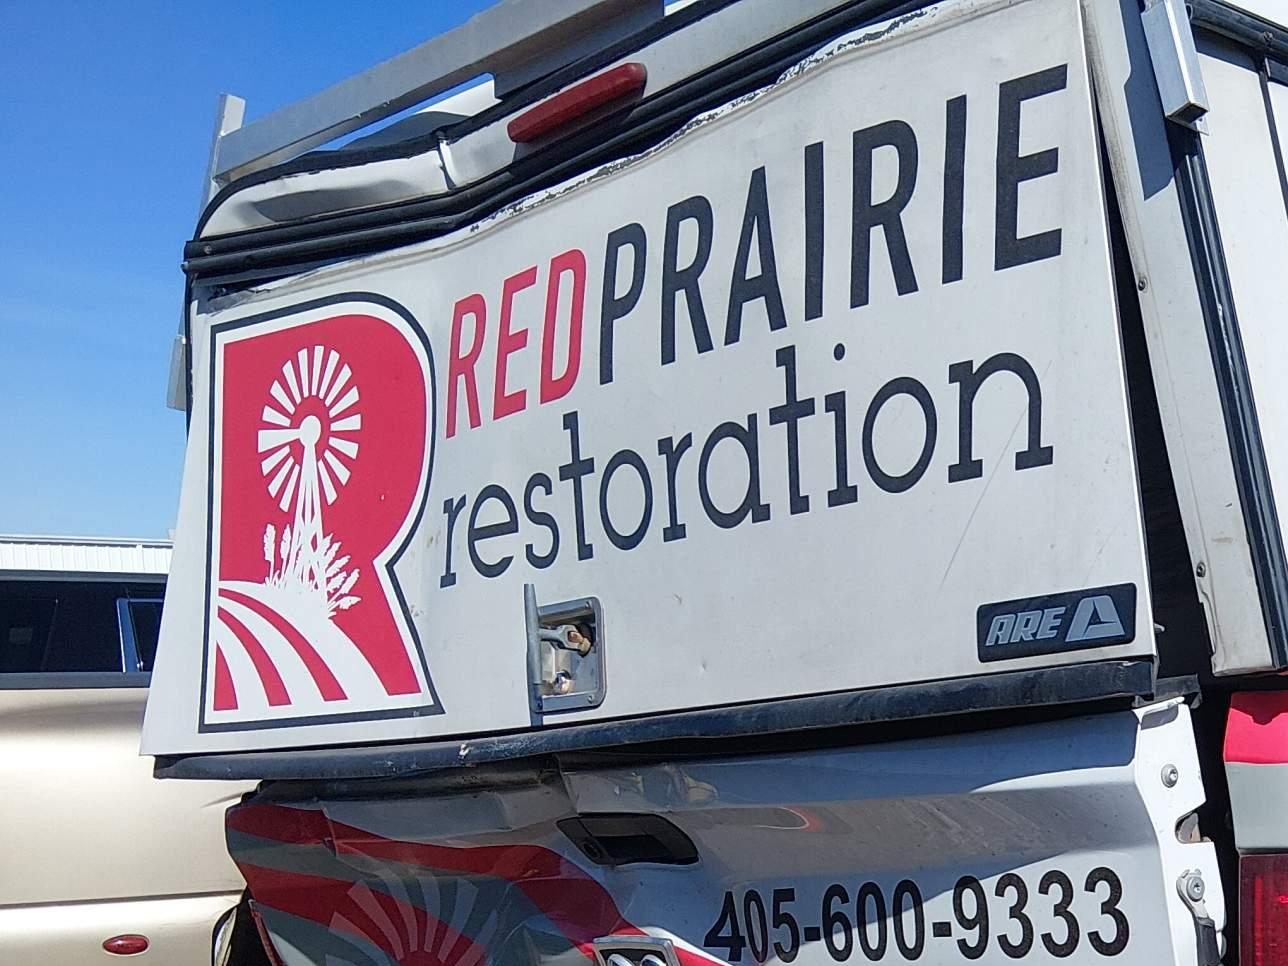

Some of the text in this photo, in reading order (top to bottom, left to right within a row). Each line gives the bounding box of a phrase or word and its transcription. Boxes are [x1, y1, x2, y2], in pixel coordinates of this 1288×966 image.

[439, 344, 1054, 589] restoration
[985, 605, 1061, 647] ARE
[703, 866, 1131, 964] 405-600-9333
